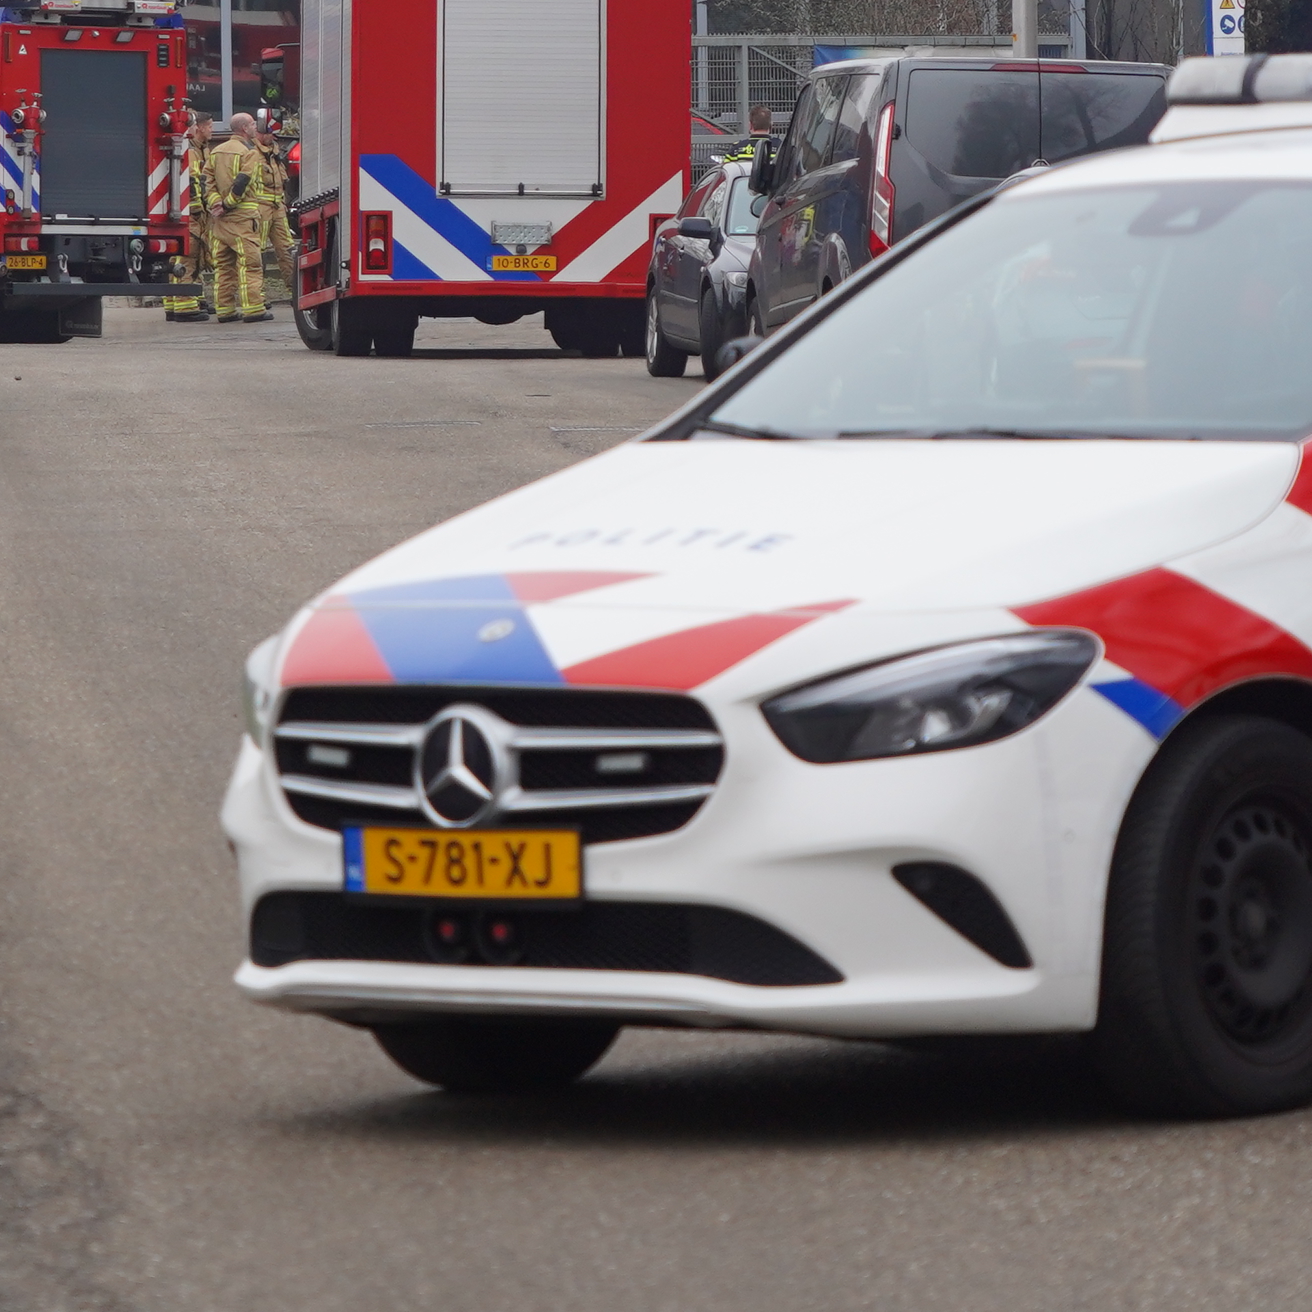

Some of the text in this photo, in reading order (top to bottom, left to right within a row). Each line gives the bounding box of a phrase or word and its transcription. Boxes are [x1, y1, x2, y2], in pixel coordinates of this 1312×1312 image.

[9, 258, 43, 267] 26-BLP-4
[497, 257, 551, 268] 10-BRG-6
[507, 528, 795, 553] POLITIE
[385, 839, 552, 887] S-781-XJ
